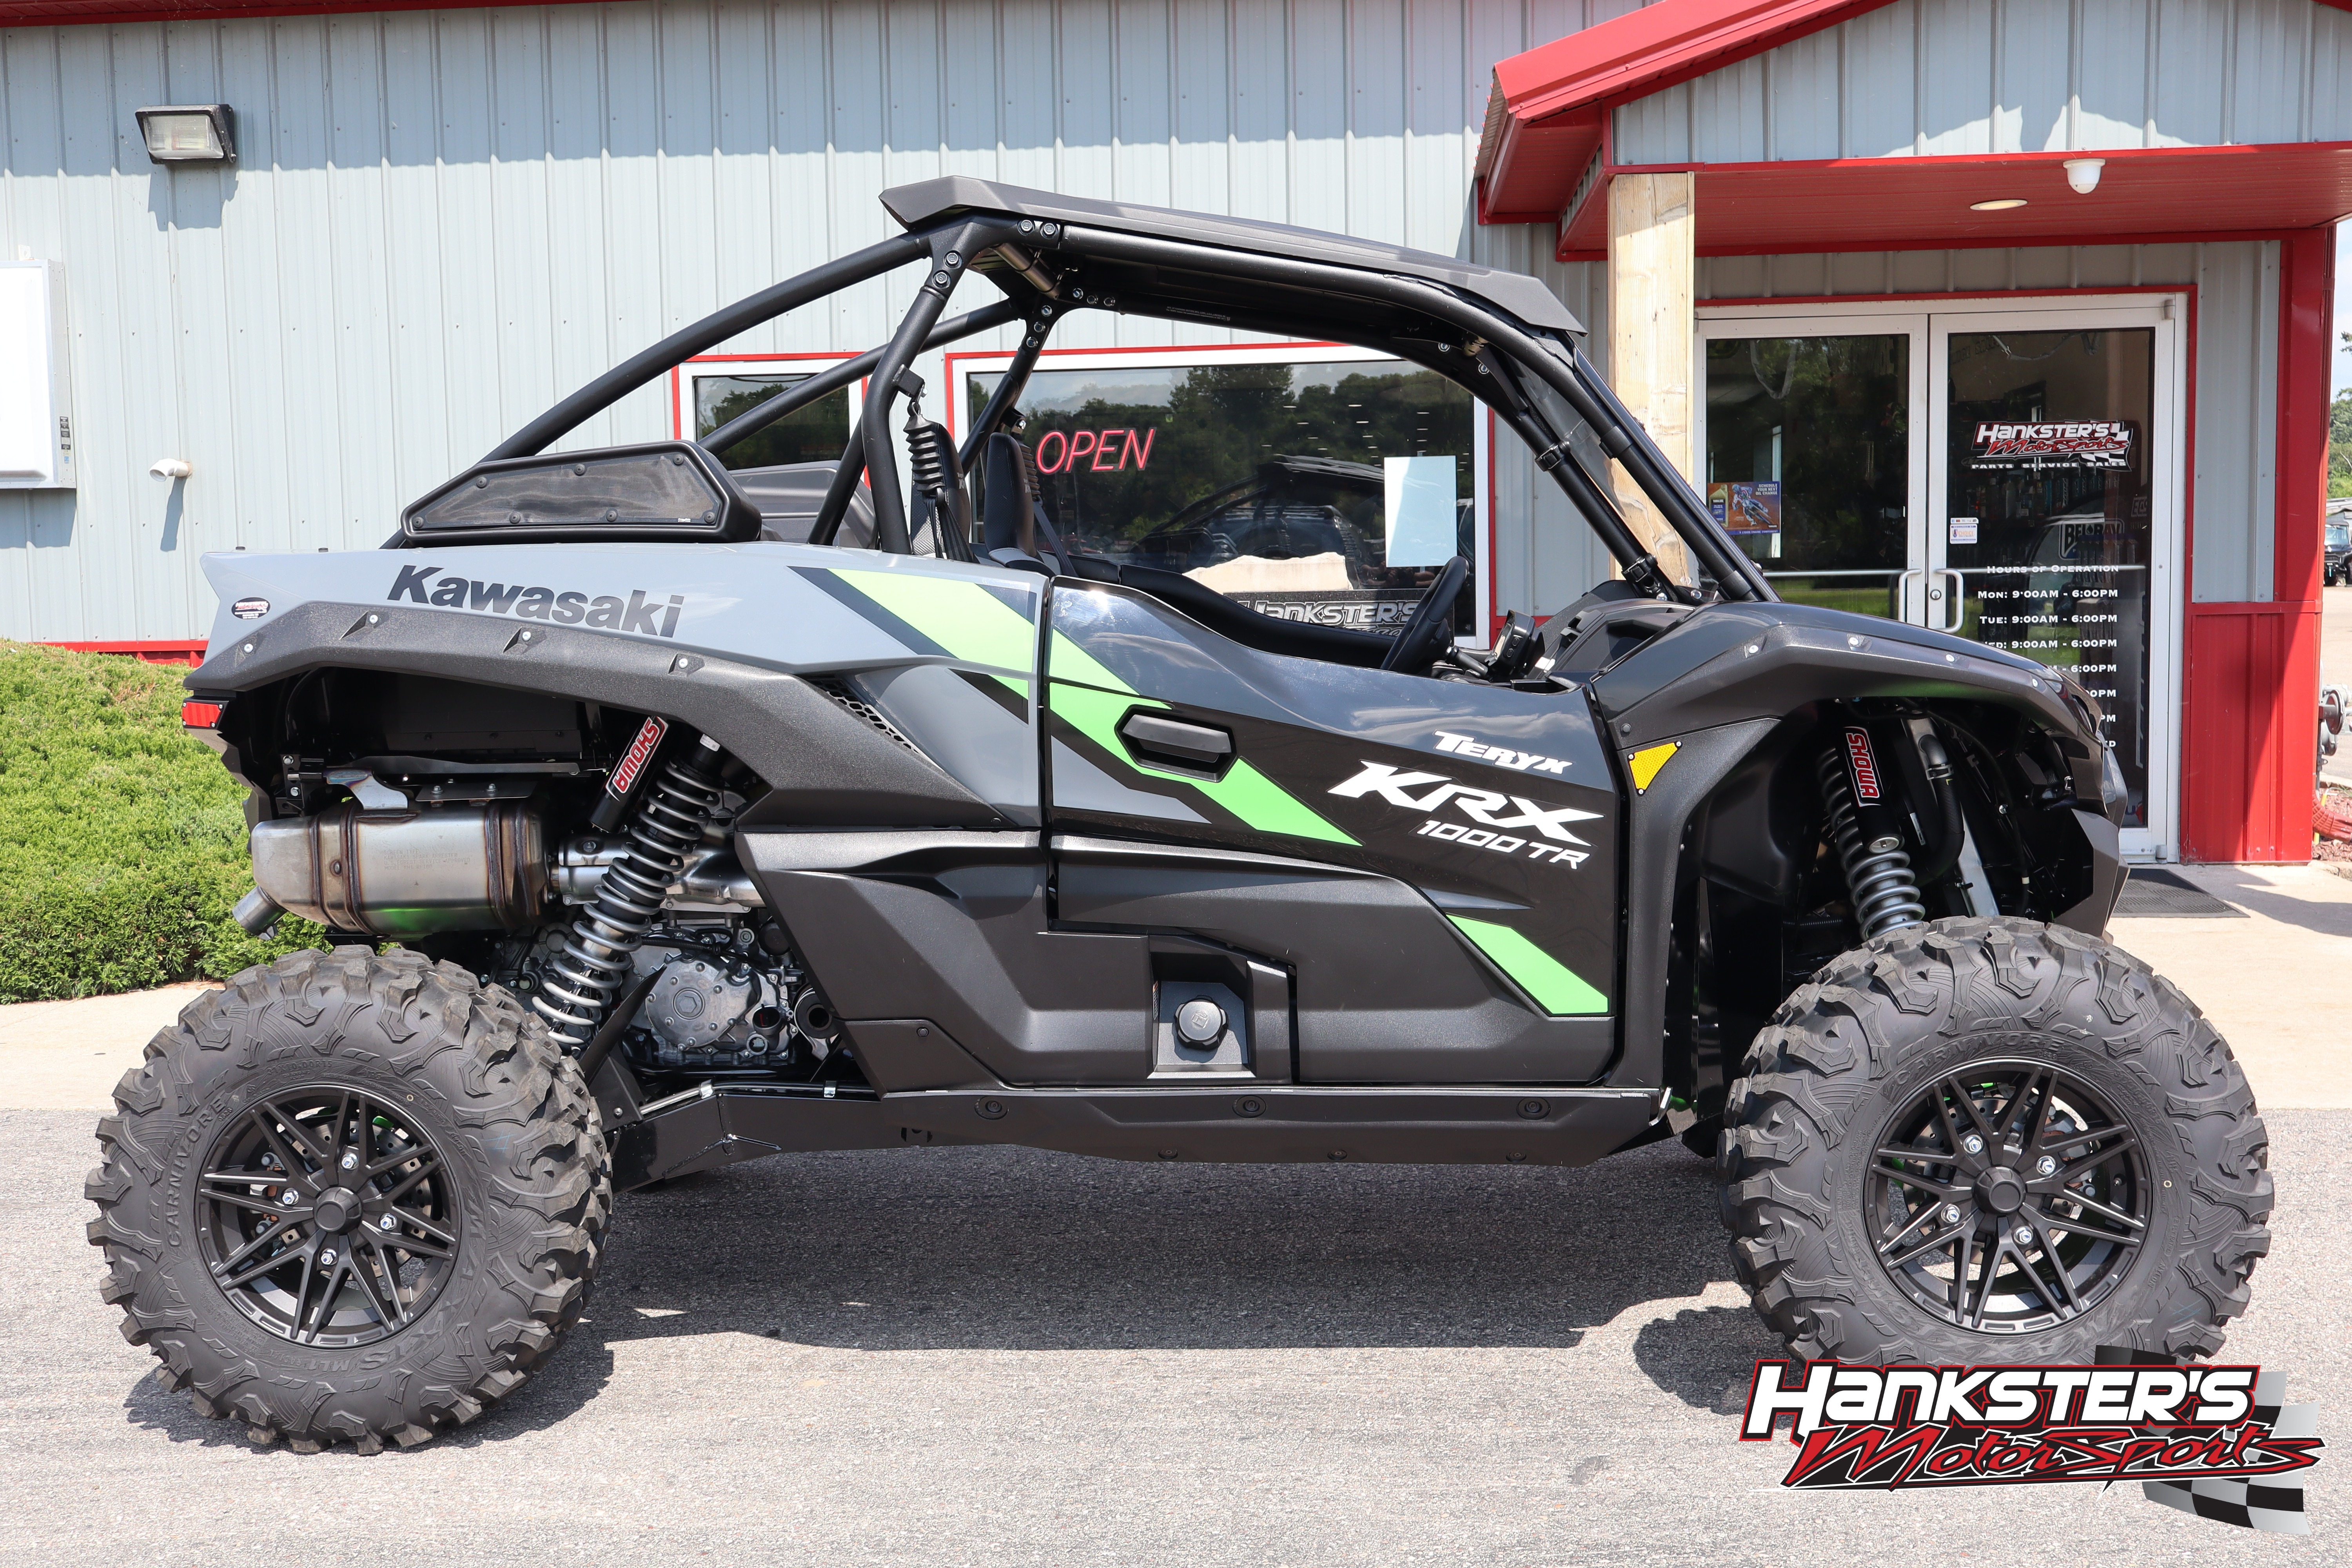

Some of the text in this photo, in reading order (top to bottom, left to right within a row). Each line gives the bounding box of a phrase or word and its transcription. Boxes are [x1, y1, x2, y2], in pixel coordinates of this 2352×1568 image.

[1036, 428, 1155, 474] OPEN
[387, 564, 685, 638] Kawasaki
[2011, 615, 2058, 623] 9:00AM
[2071, 614, 2118, 622] 6:00PM
[2071, 589, 2118, 598] 6:00PM
[2011, 640, 2058, 649] 9:00AM
[2071, 639, 2118, 648] 6:00PM
[2071, 664, 2117, 673] 6:00PM
[612, 716, 660, 794] SHOWA
[1846, 733, 1880, 799] SHOWA
[1327, 759, 1606, 847] KRX
[165, 1096, 227, 1247] CARNIVORE
